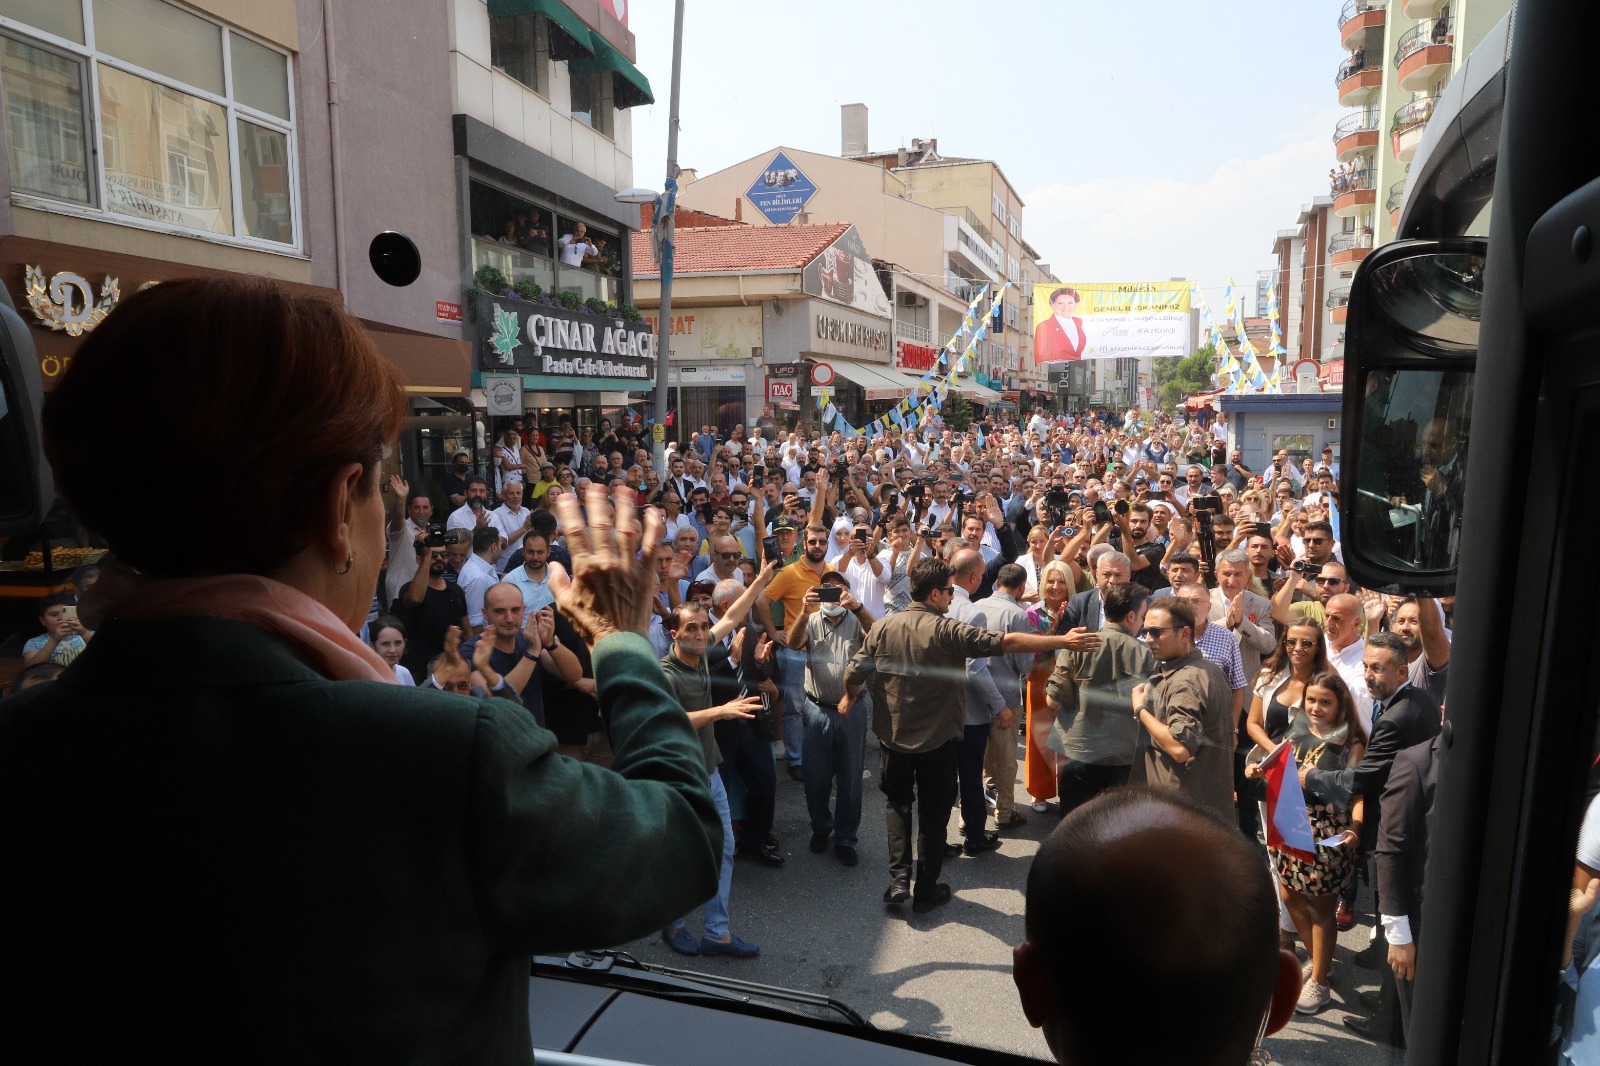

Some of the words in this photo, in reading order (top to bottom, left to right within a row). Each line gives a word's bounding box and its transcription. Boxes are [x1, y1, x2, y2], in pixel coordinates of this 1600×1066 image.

[772, 197, 802, 206] BİLİMLERİ
[1125, 304, 1181, 312] BŞKANIMIZ
[527, 314, 597, 356] ÇINAR
[601, 320, 654, 358] AĞACI
[542, 355, 573, 374] Pasta
[572, 358, 596, 375] Cafe
[596, 359, 606, 376] &
[604, 360, 647, 377] Restaurant
[775, 366, 794, 374] UFO
[772, 384, 792, 397] TAÇ
